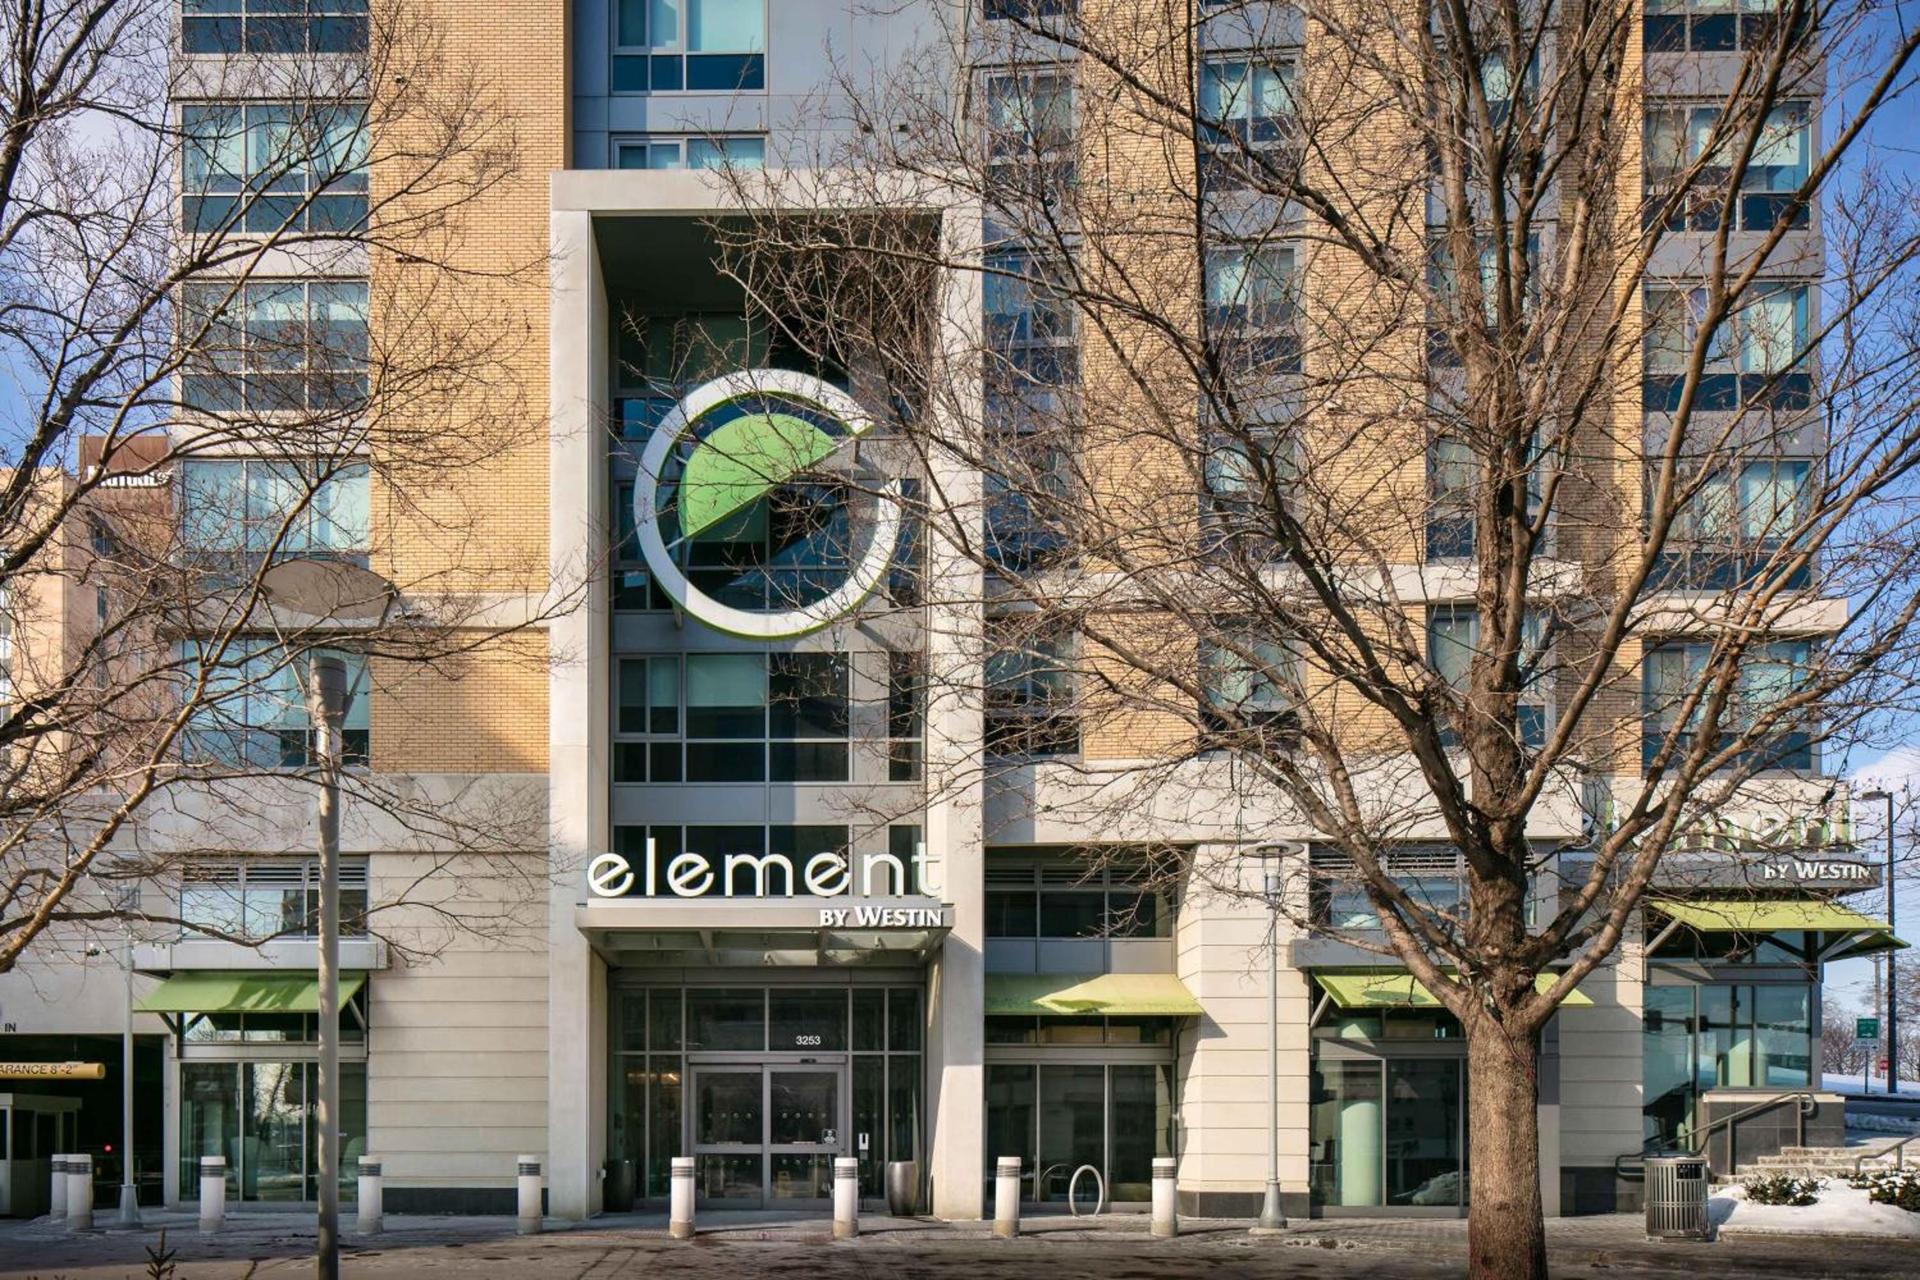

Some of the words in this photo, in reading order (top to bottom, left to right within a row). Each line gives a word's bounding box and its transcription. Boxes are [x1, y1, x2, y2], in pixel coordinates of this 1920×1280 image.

[586, 837, 942, 898] element
[820, 909, 847, 926] BY
[854, 906, 942, 926] WESTIN
[4, 1023, 16, 1033] IN
[795, 1035, 821, 1045] 3253
